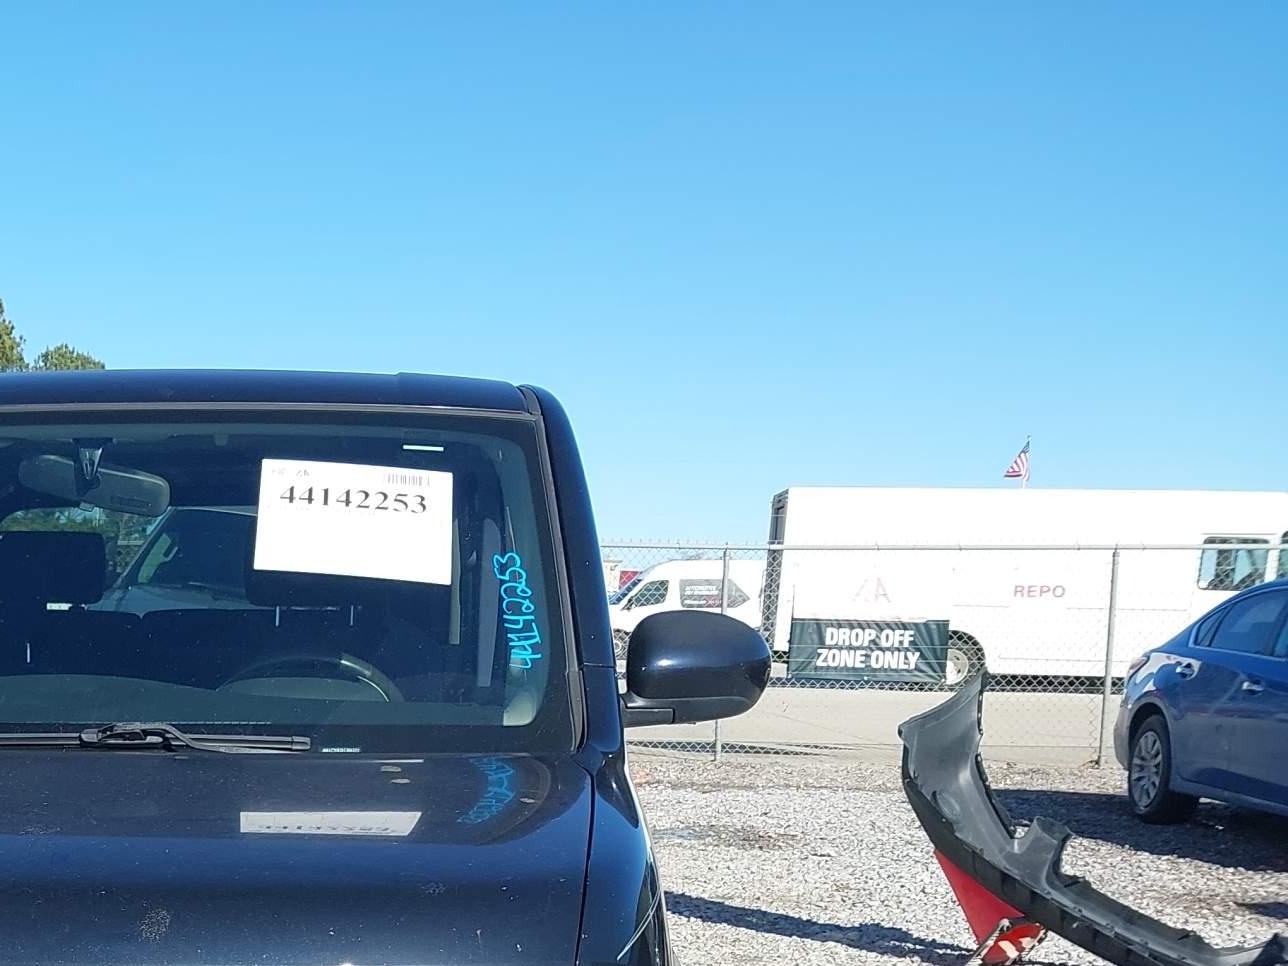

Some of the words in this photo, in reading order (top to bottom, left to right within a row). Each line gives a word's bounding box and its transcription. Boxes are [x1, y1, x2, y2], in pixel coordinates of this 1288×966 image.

[279, 485, 428, 515] 44142253
[1013, 584, 1067, 599] REPO
[824, 627, 877, 647] DROP
[880, 628, 915, 648] OFF
[816, 648, 866, 668] ZONE
[869, 649, 921, 670] ONLY
